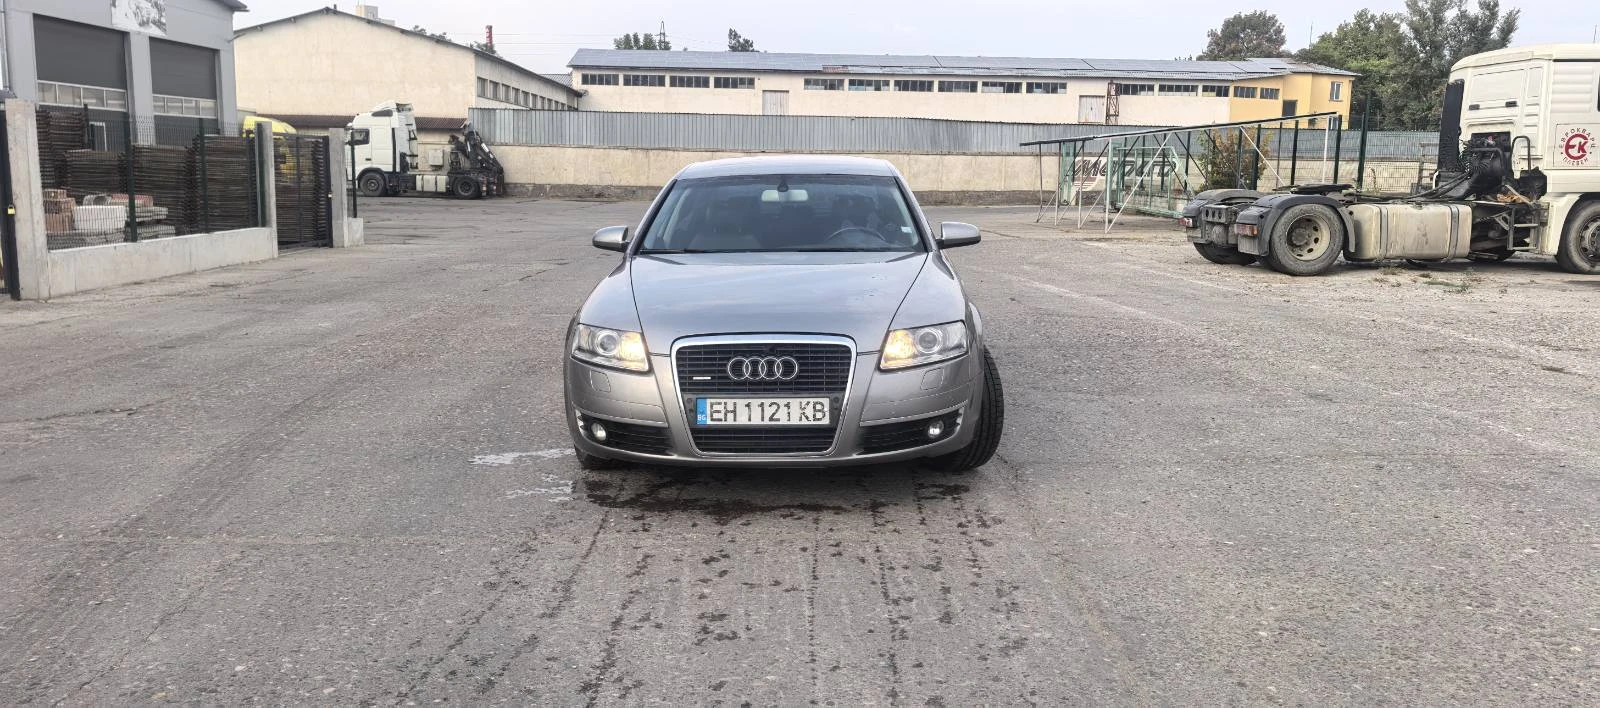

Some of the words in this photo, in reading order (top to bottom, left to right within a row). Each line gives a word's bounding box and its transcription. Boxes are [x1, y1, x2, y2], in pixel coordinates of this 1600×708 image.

[709, 401, 737, 422] EH
[744, 401, 791, 422] 1121
[798, 400, 828, 422] KB
